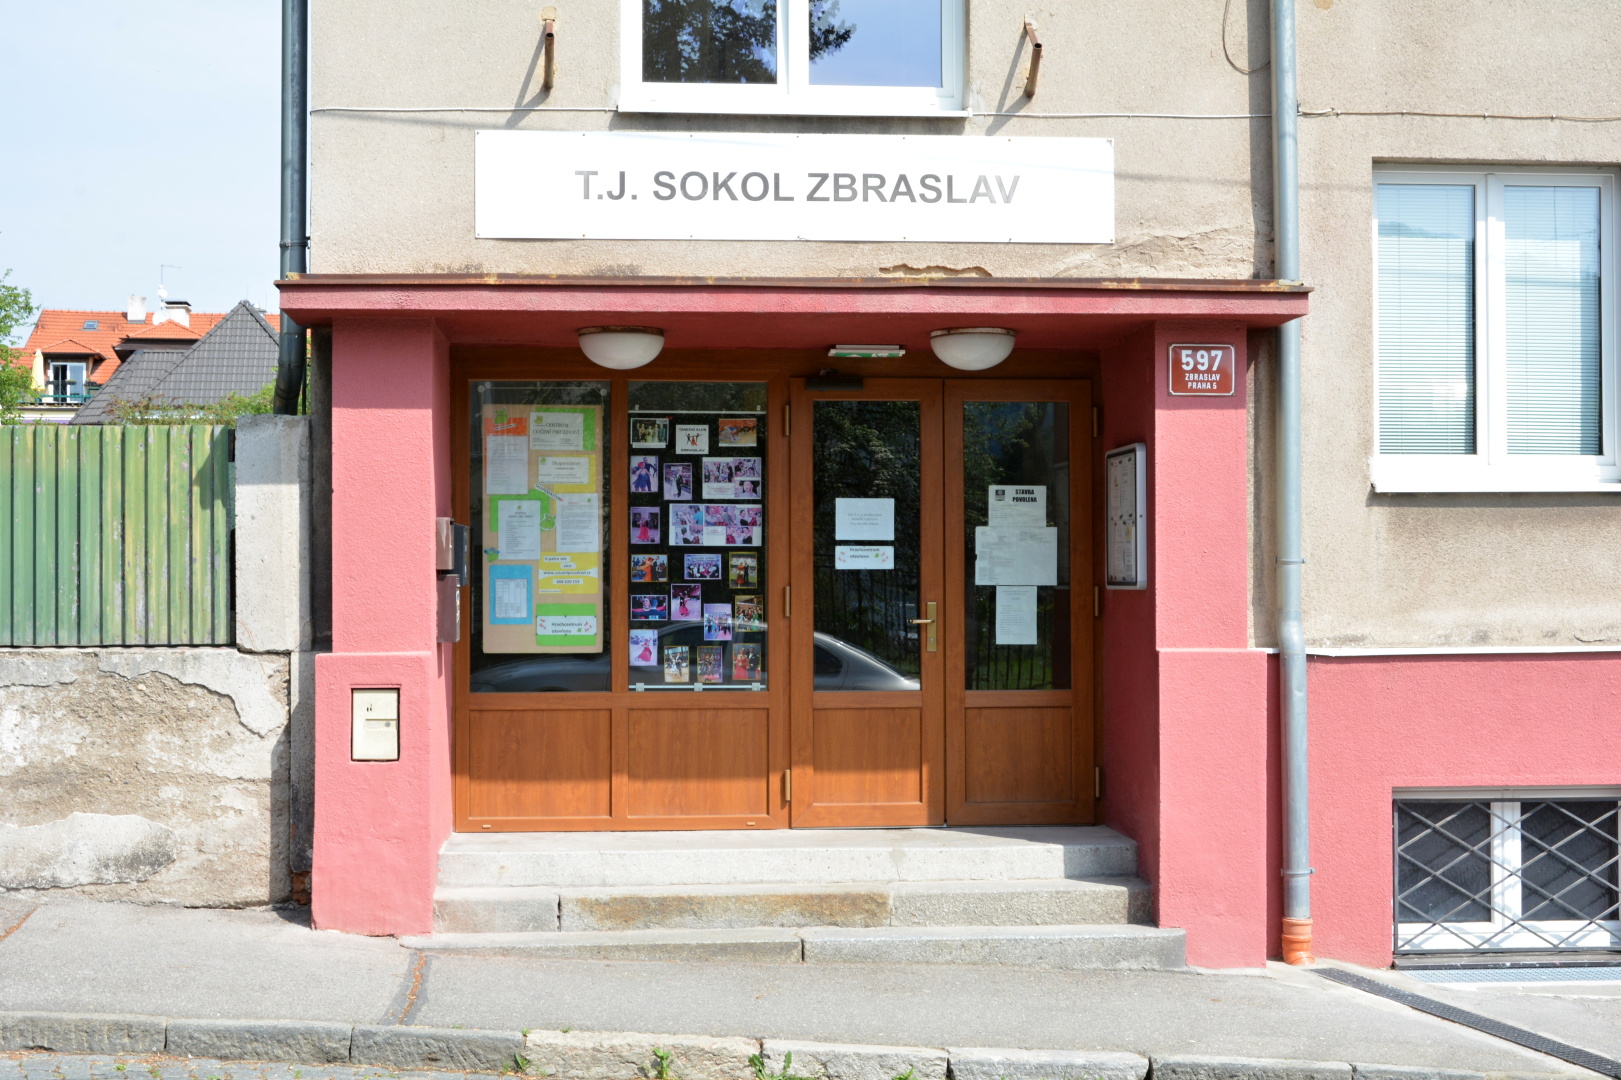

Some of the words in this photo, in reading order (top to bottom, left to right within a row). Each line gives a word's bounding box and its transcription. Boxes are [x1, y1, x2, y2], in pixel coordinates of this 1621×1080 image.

[575, 170, 638, 201] T.J.
[652, 171, 795, 201] SOKOL
[807, 172, 1020, 204] ZBRASLAV
[1181, 349, 1223, 371] 597
[1184, 373, 1221, 381] ZBRASLAV
[1187, 381, 1211, 389] PRAHA
[1212, 382, 1217, 390] 5
